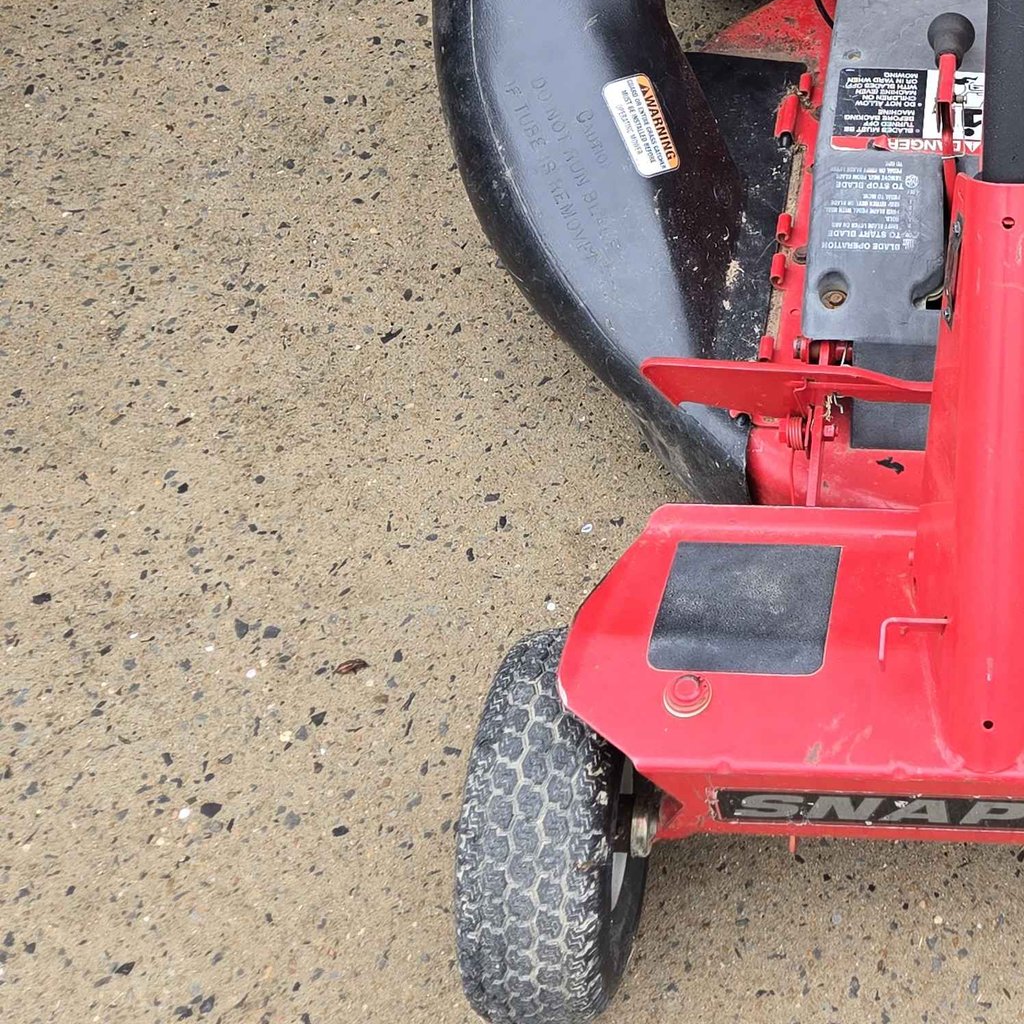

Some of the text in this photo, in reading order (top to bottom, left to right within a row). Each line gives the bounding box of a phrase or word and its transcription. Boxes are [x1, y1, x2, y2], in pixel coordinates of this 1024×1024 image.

[622, 90, 632, 104] MUST
[632, 114, 647, 142] INSTALLED
[644, 143, 656, 163] BEFORE
[638, 107, 649, 125] ENTIRE
[646, 127, 657, 144] GRASS
[645, 95, 676, 160] WARNING
[631, 134, 643, 155] MOWER
[836, 181, 864, 189] BLADE
[858, 230, 886, 238] START
[821, 241, 870, 249] OPERATION
